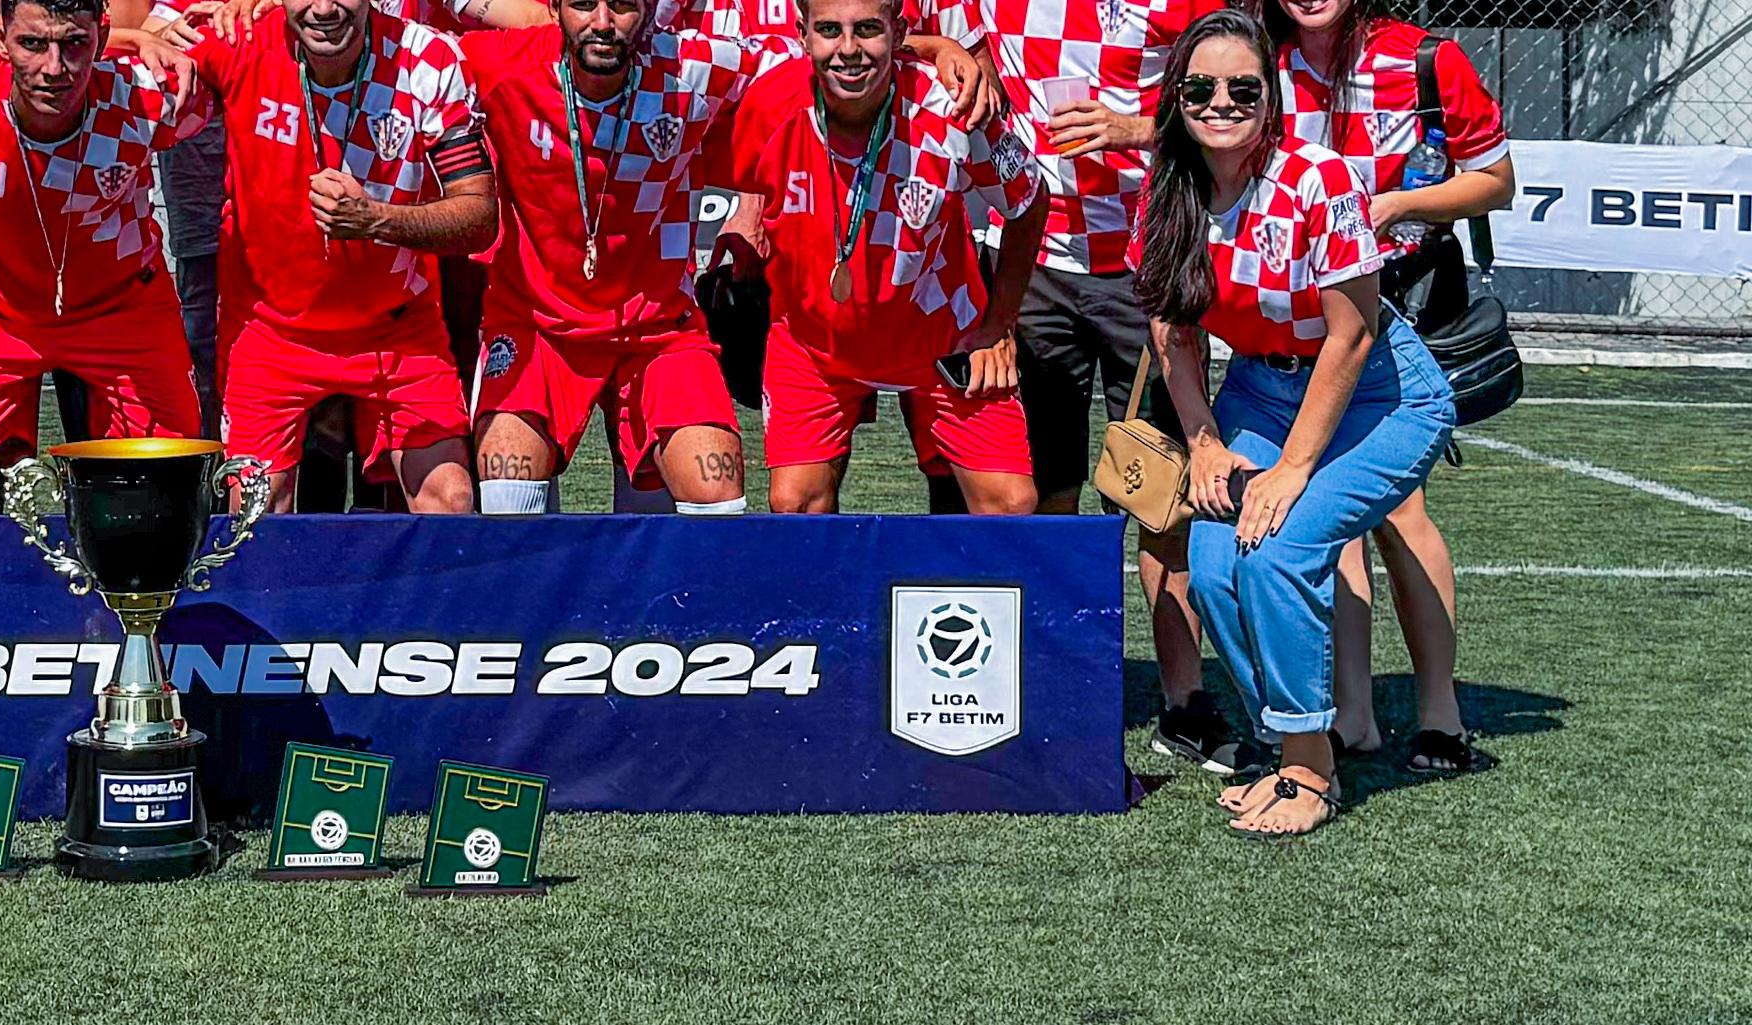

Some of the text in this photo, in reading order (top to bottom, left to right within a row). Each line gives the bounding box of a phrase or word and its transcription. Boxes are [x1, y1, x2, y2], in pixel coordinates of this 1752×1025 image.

[255, 97, 301, 146] 23
[530, 119, 554, 160] 4
[783, 171, 815, 215] 51
[1504, 187, 1564, 222] 7
[481, 453, 532, 480] 1965
[536, 643, 820, 695] 2024
[931, 693, 979, 706] LIGA
[906, 712, 1005, 725] F7 BETIM
[108, 780, 188, 796] CAMPEÃO
